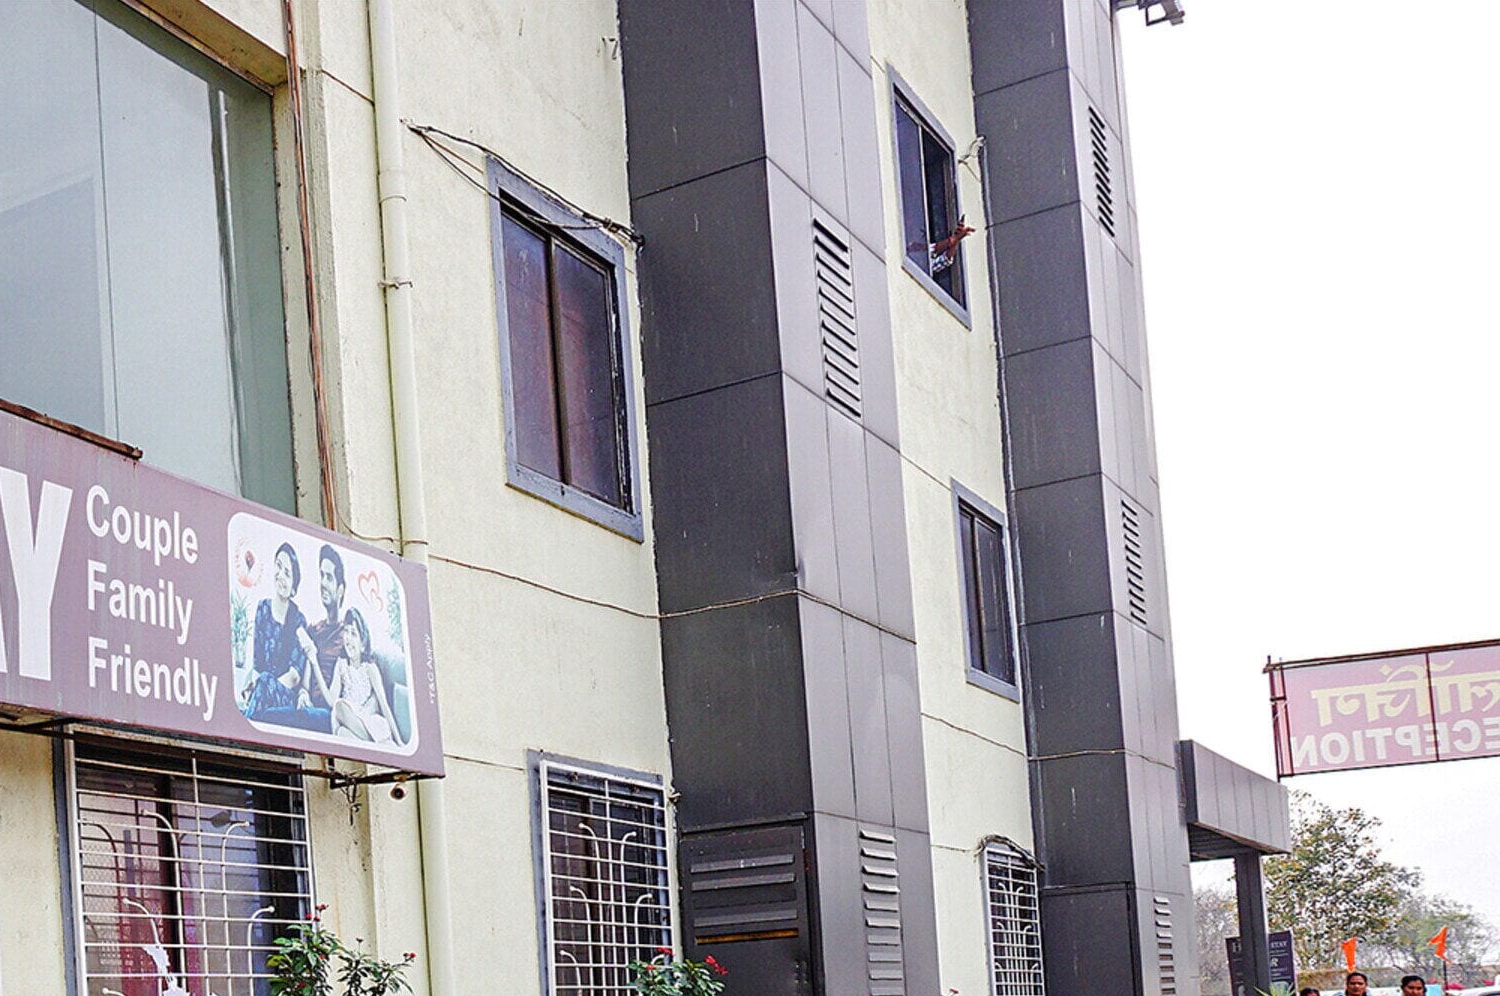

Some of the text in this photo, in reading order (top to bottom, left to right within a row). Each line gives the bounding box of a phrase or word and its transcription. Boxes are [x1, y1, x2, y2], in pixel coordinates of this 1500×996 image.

[85, 484, 199, 566] Couple
[86, 559, 193, 645] Family
[87, 636, 218, 722] Friendly
